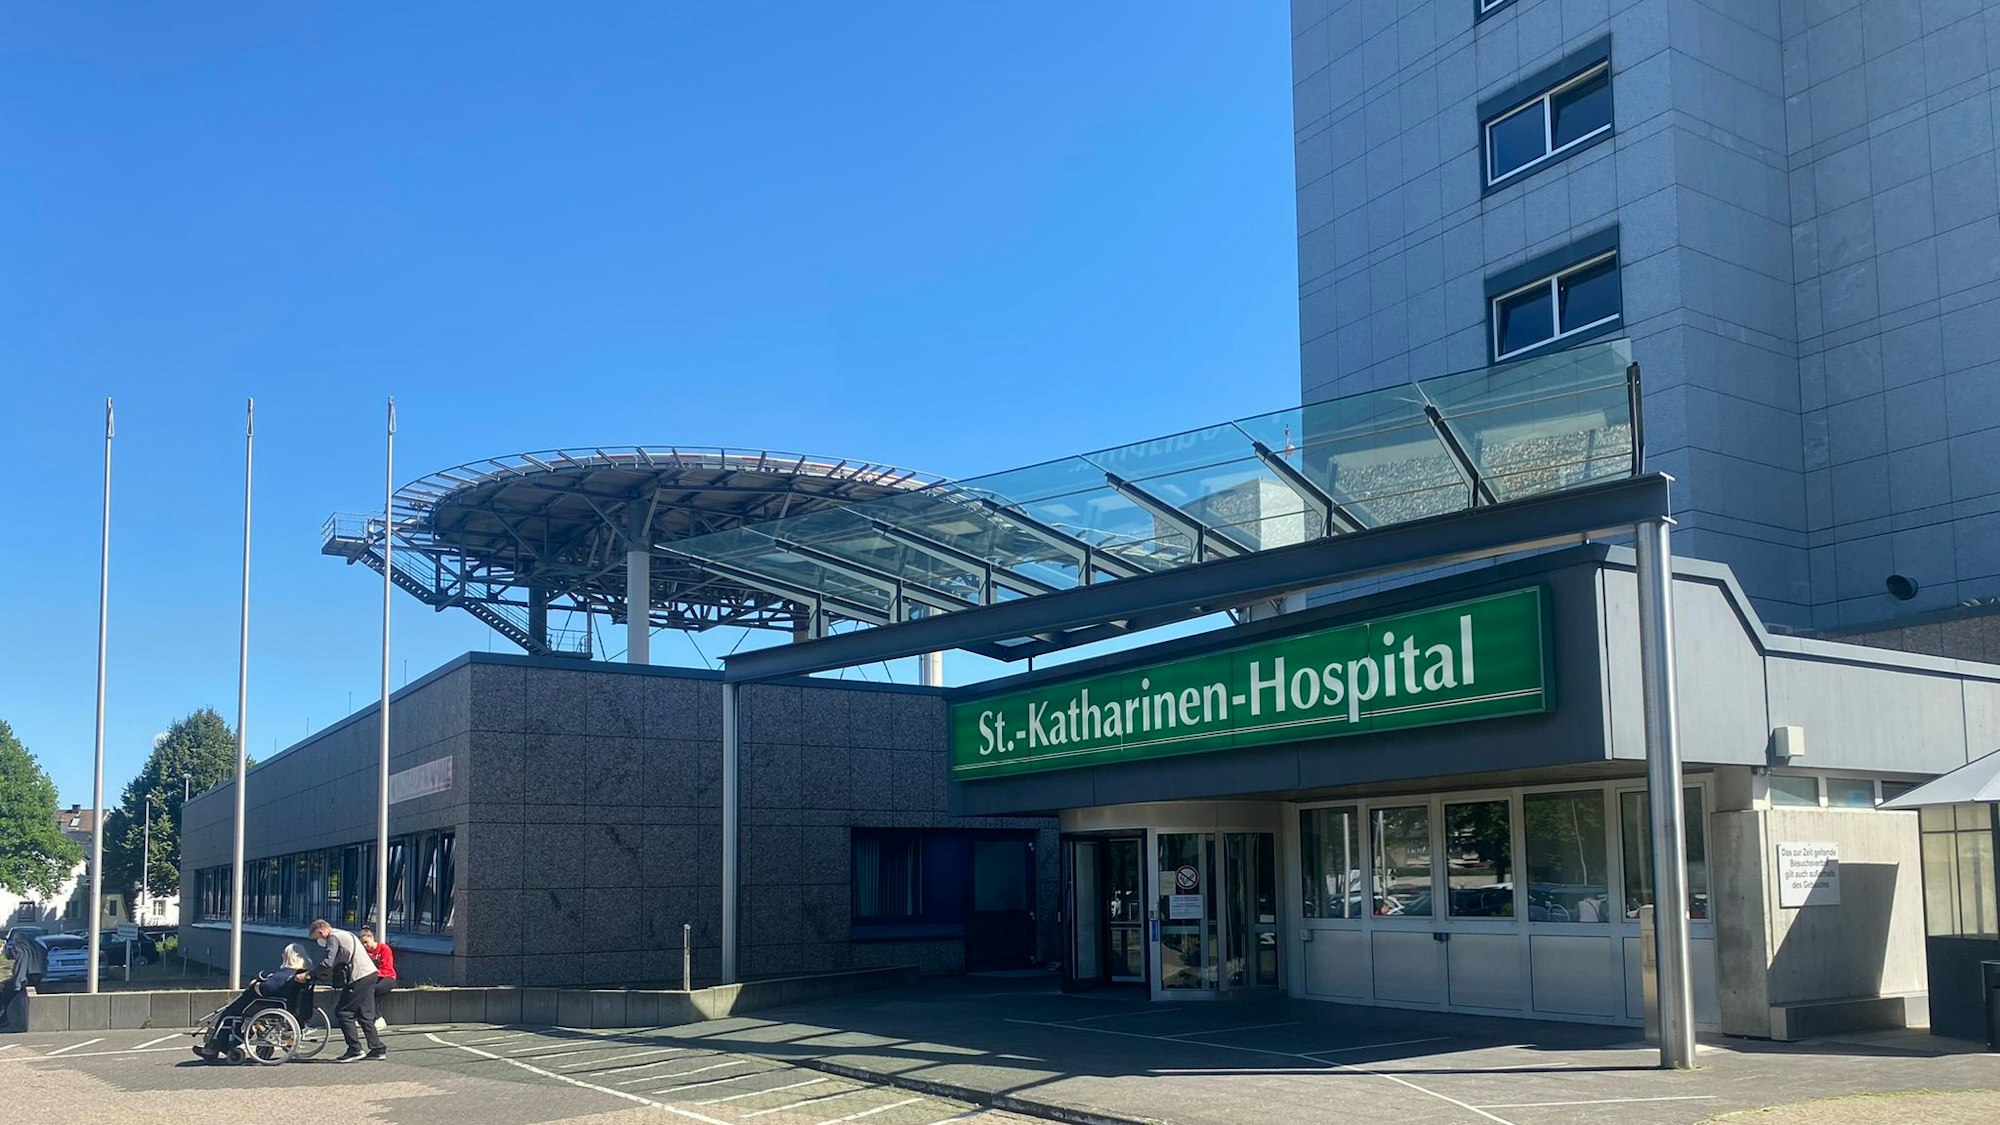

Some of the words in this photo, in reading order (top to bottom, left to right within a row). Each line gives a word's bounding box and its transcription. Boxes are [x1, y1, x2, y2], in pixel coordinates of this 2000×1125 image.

[978, 614, 1475, 756] St.-Katharinen-Hospital
[1781, 848, 1792, 857] Das
[1793, 849, 1802, 857] zur
[1802, 848, 1814, 857] Zeit
[1795, 870, 1808, 878] auch
